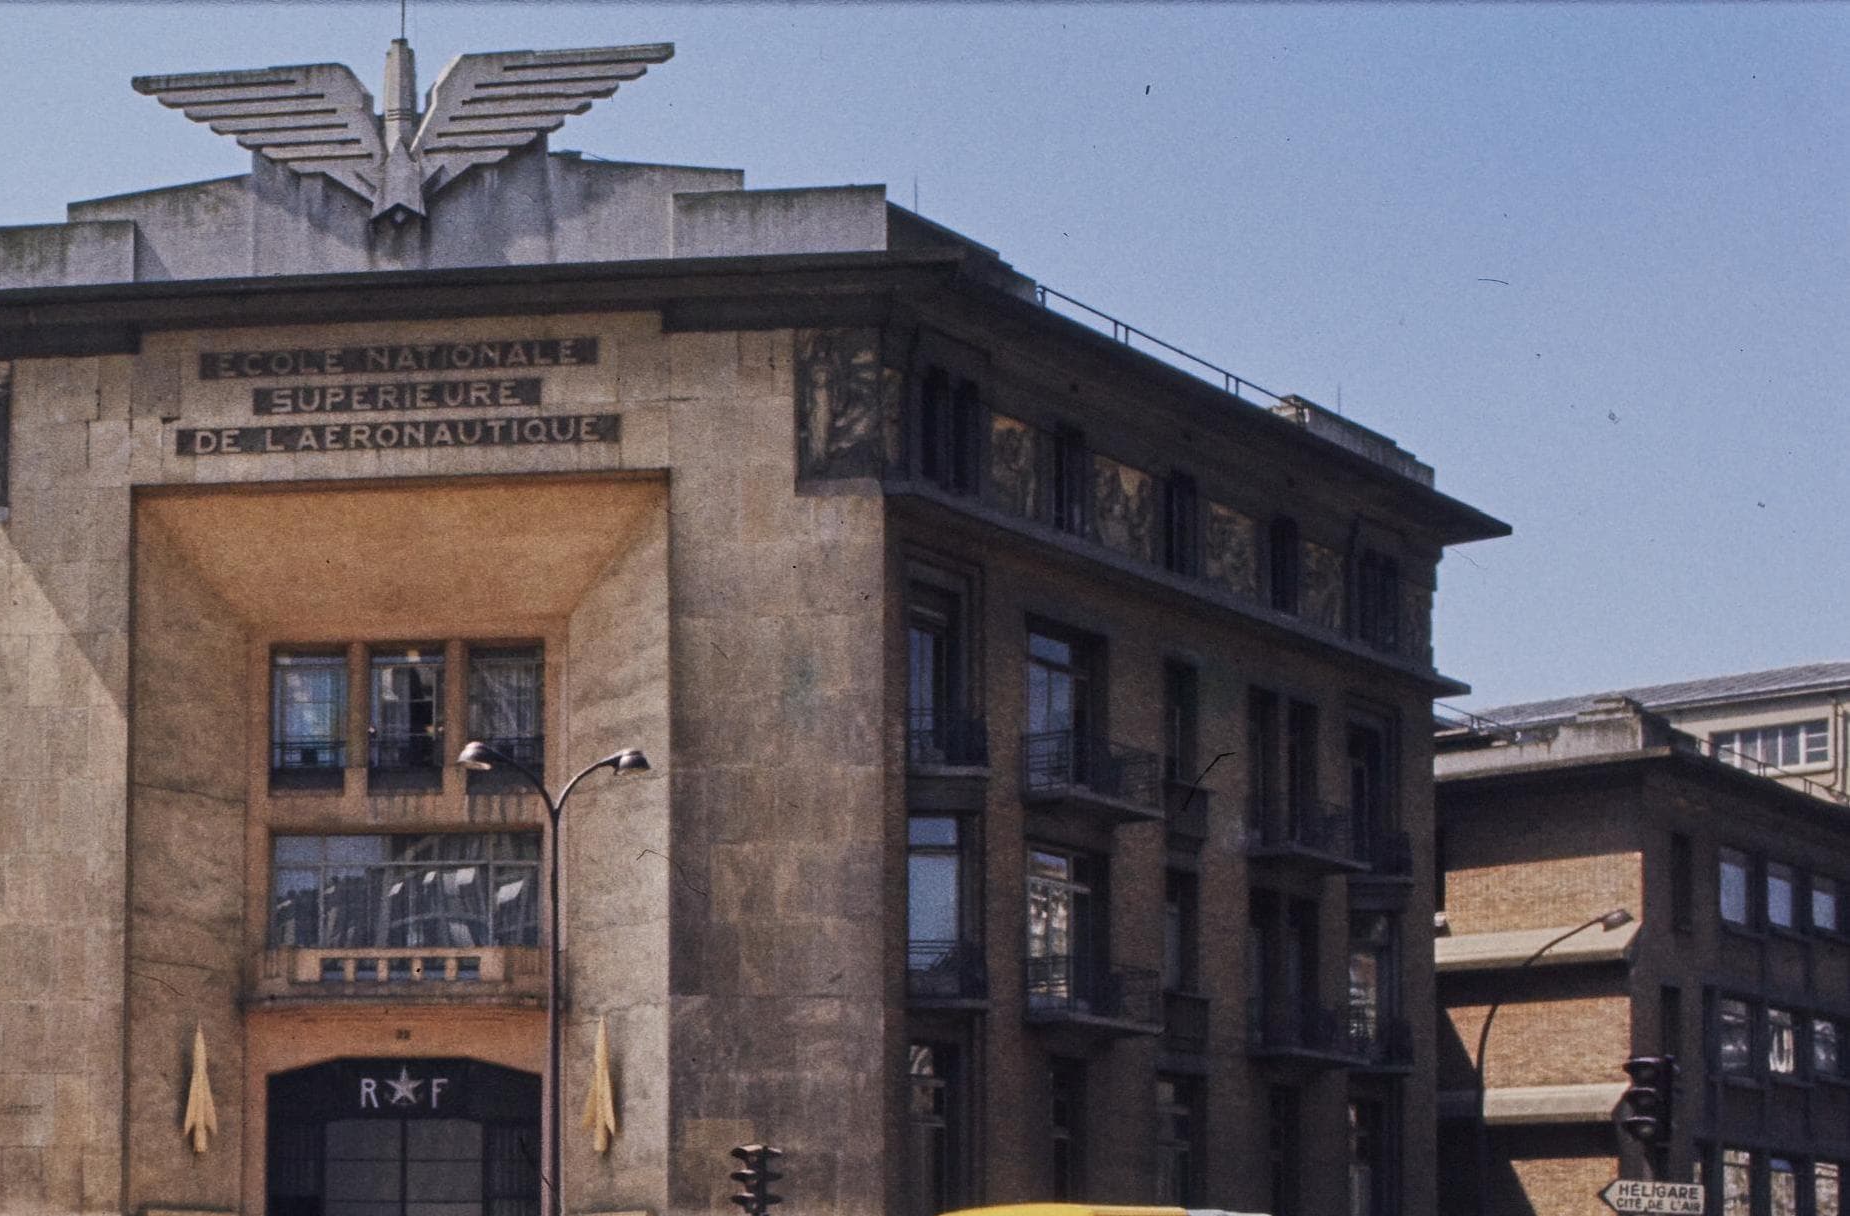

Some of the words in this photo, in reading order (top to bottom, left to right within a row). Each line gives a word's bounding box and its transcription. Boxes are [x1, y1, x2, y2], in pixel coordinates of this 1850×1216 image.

[218, 350, 345, 377] ECOLE
[367, 339, 578, 371] NATIONALE
[270, 381, 522, 413] SUPERIEURE
[194, 430, 242, 454] DE
[265, 418, 600, 451] LAERONAUTIQUE
[360, 1078, 379, 1108] R
[431, 1078, 448, 1108] F
[1648, 1200, 1664, 1211] DE
[1670, 1201, 1702, 1213] L'AIR
